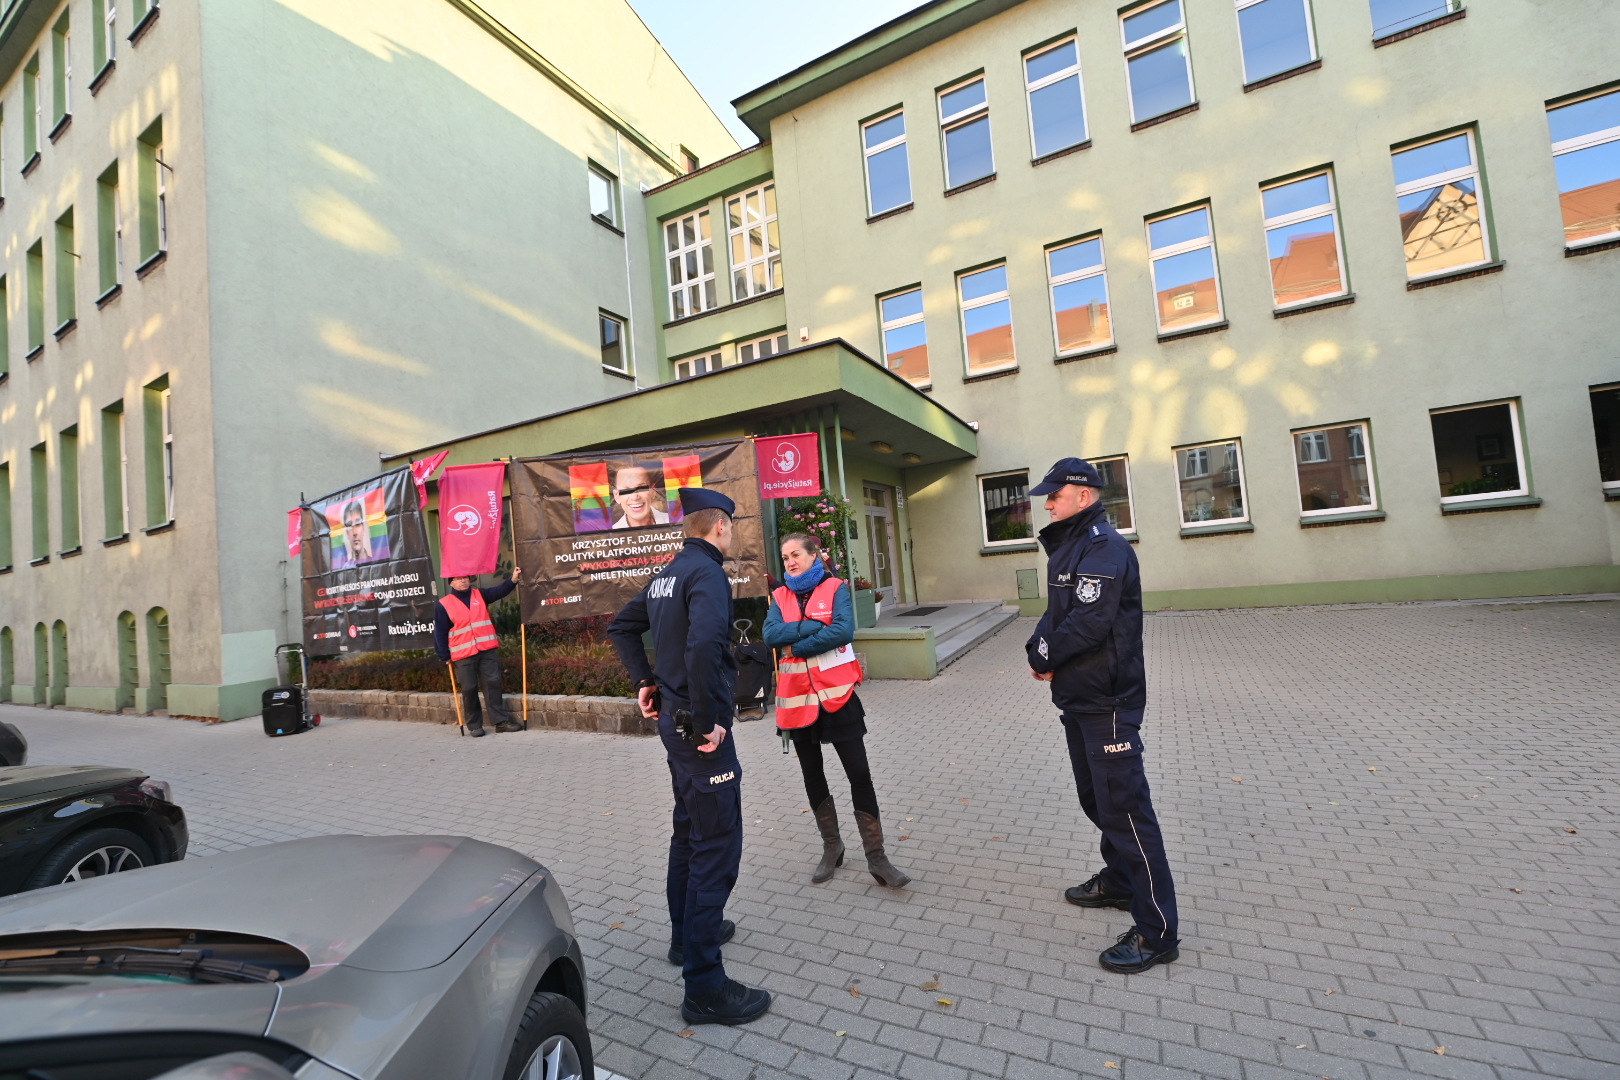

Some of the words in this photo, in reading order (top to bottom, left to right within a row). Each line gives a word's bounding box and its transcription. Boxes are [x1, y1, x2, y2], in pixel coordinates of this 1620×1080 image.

[572, 536, 626, 551] KRZYSZTOF
[638, 531, 683, 544] DZIAŁACZ
[555, 551, 595, 563] POLITYK
[596, 545, 653, 560] PLATFORMY
[580, 556, 649, 571] WYKORZYSTAŁ
[590, 567, 651, 581] NIELETNIEGO
[403, 586, 426, 597] DZECI
[540, 595, 582, 606] #STOPLGBT
[1104, 741, 1132, 753] POLICJA
[709, 771, 735, 785] POLICJA
